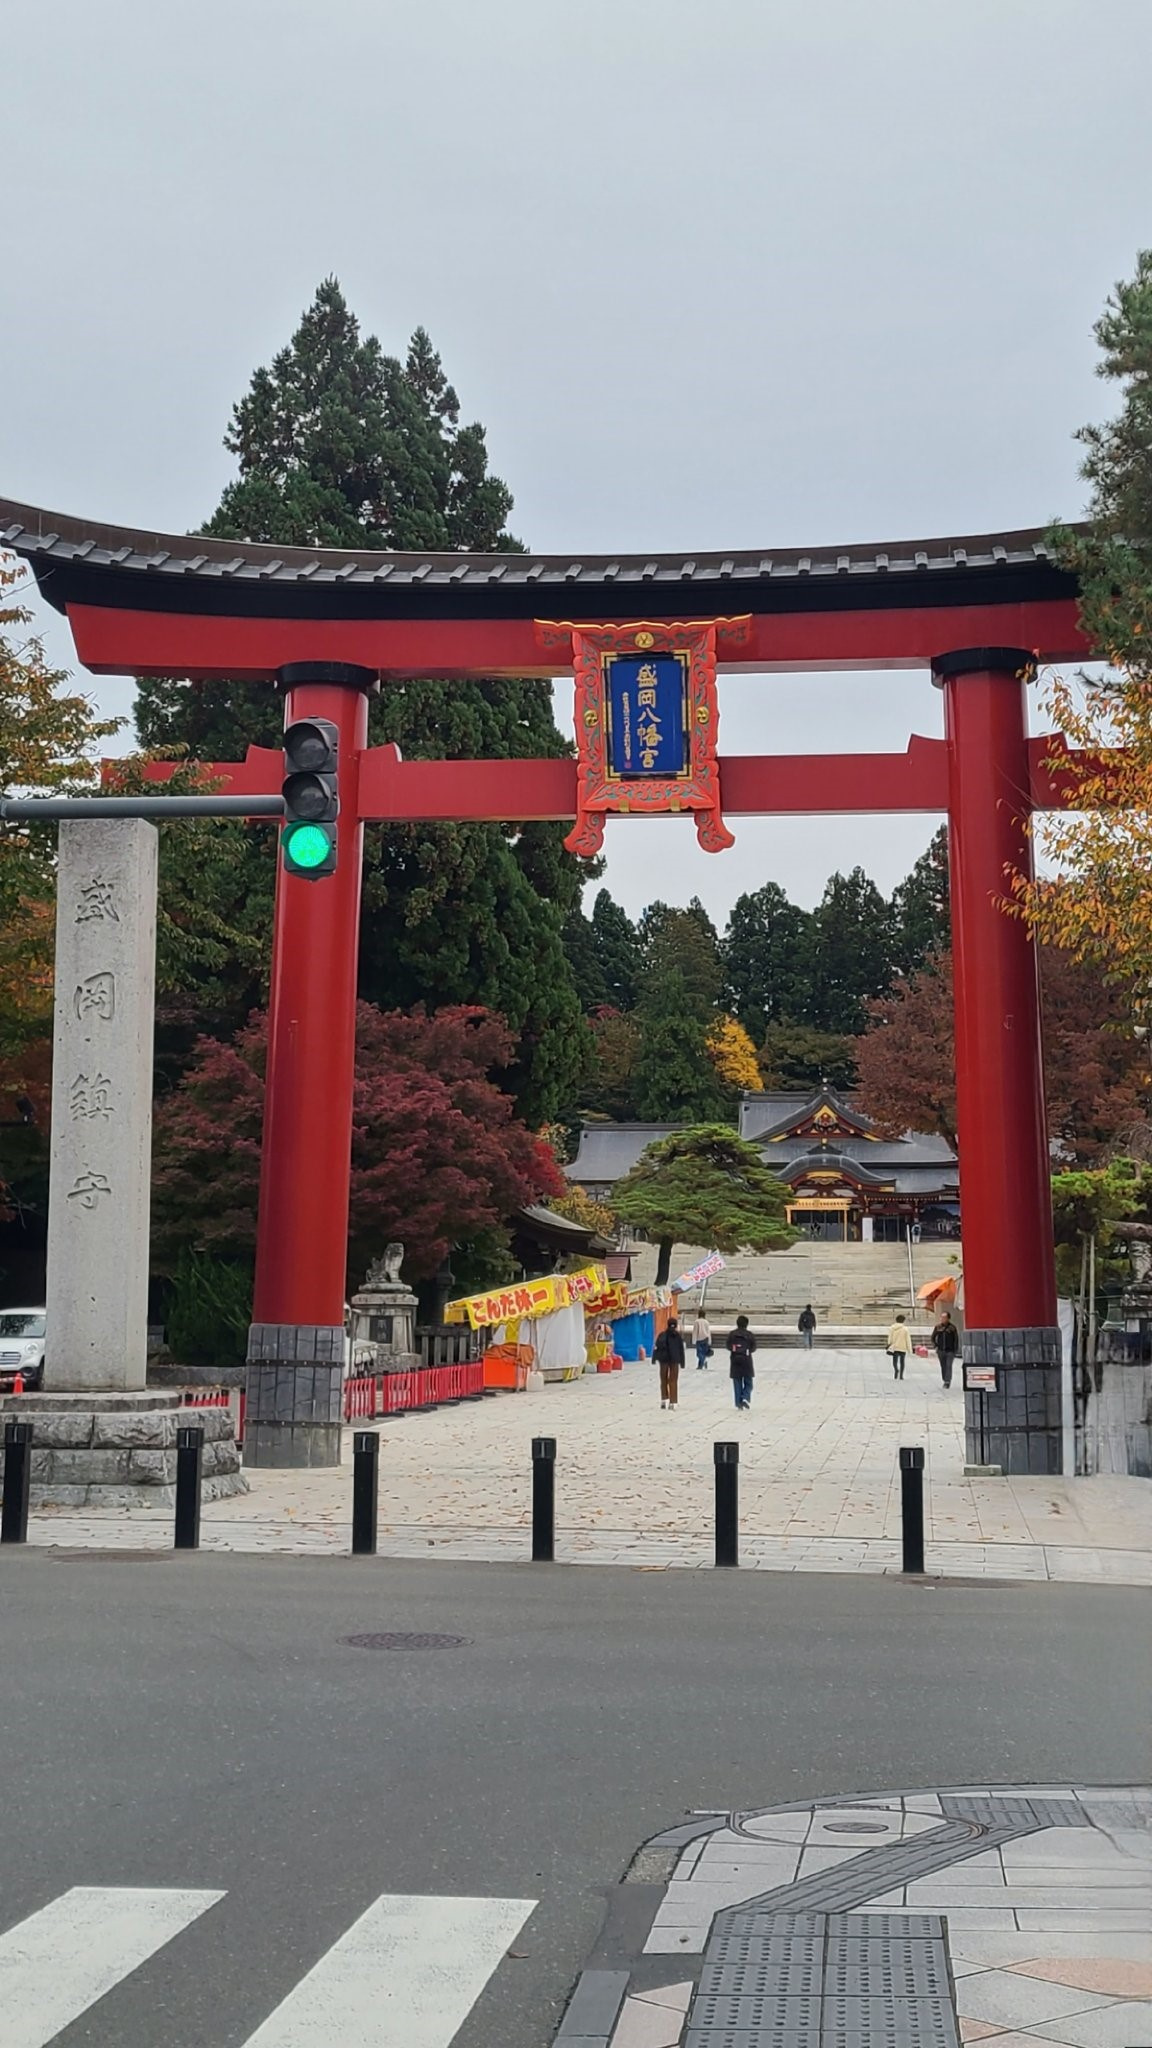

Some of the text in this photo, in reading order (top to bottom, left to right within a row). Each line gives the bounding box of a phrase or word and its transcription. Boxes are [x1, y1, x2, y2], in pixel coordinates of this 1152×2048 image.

[636, 663, 664, 769] 盛岡八幡宮
